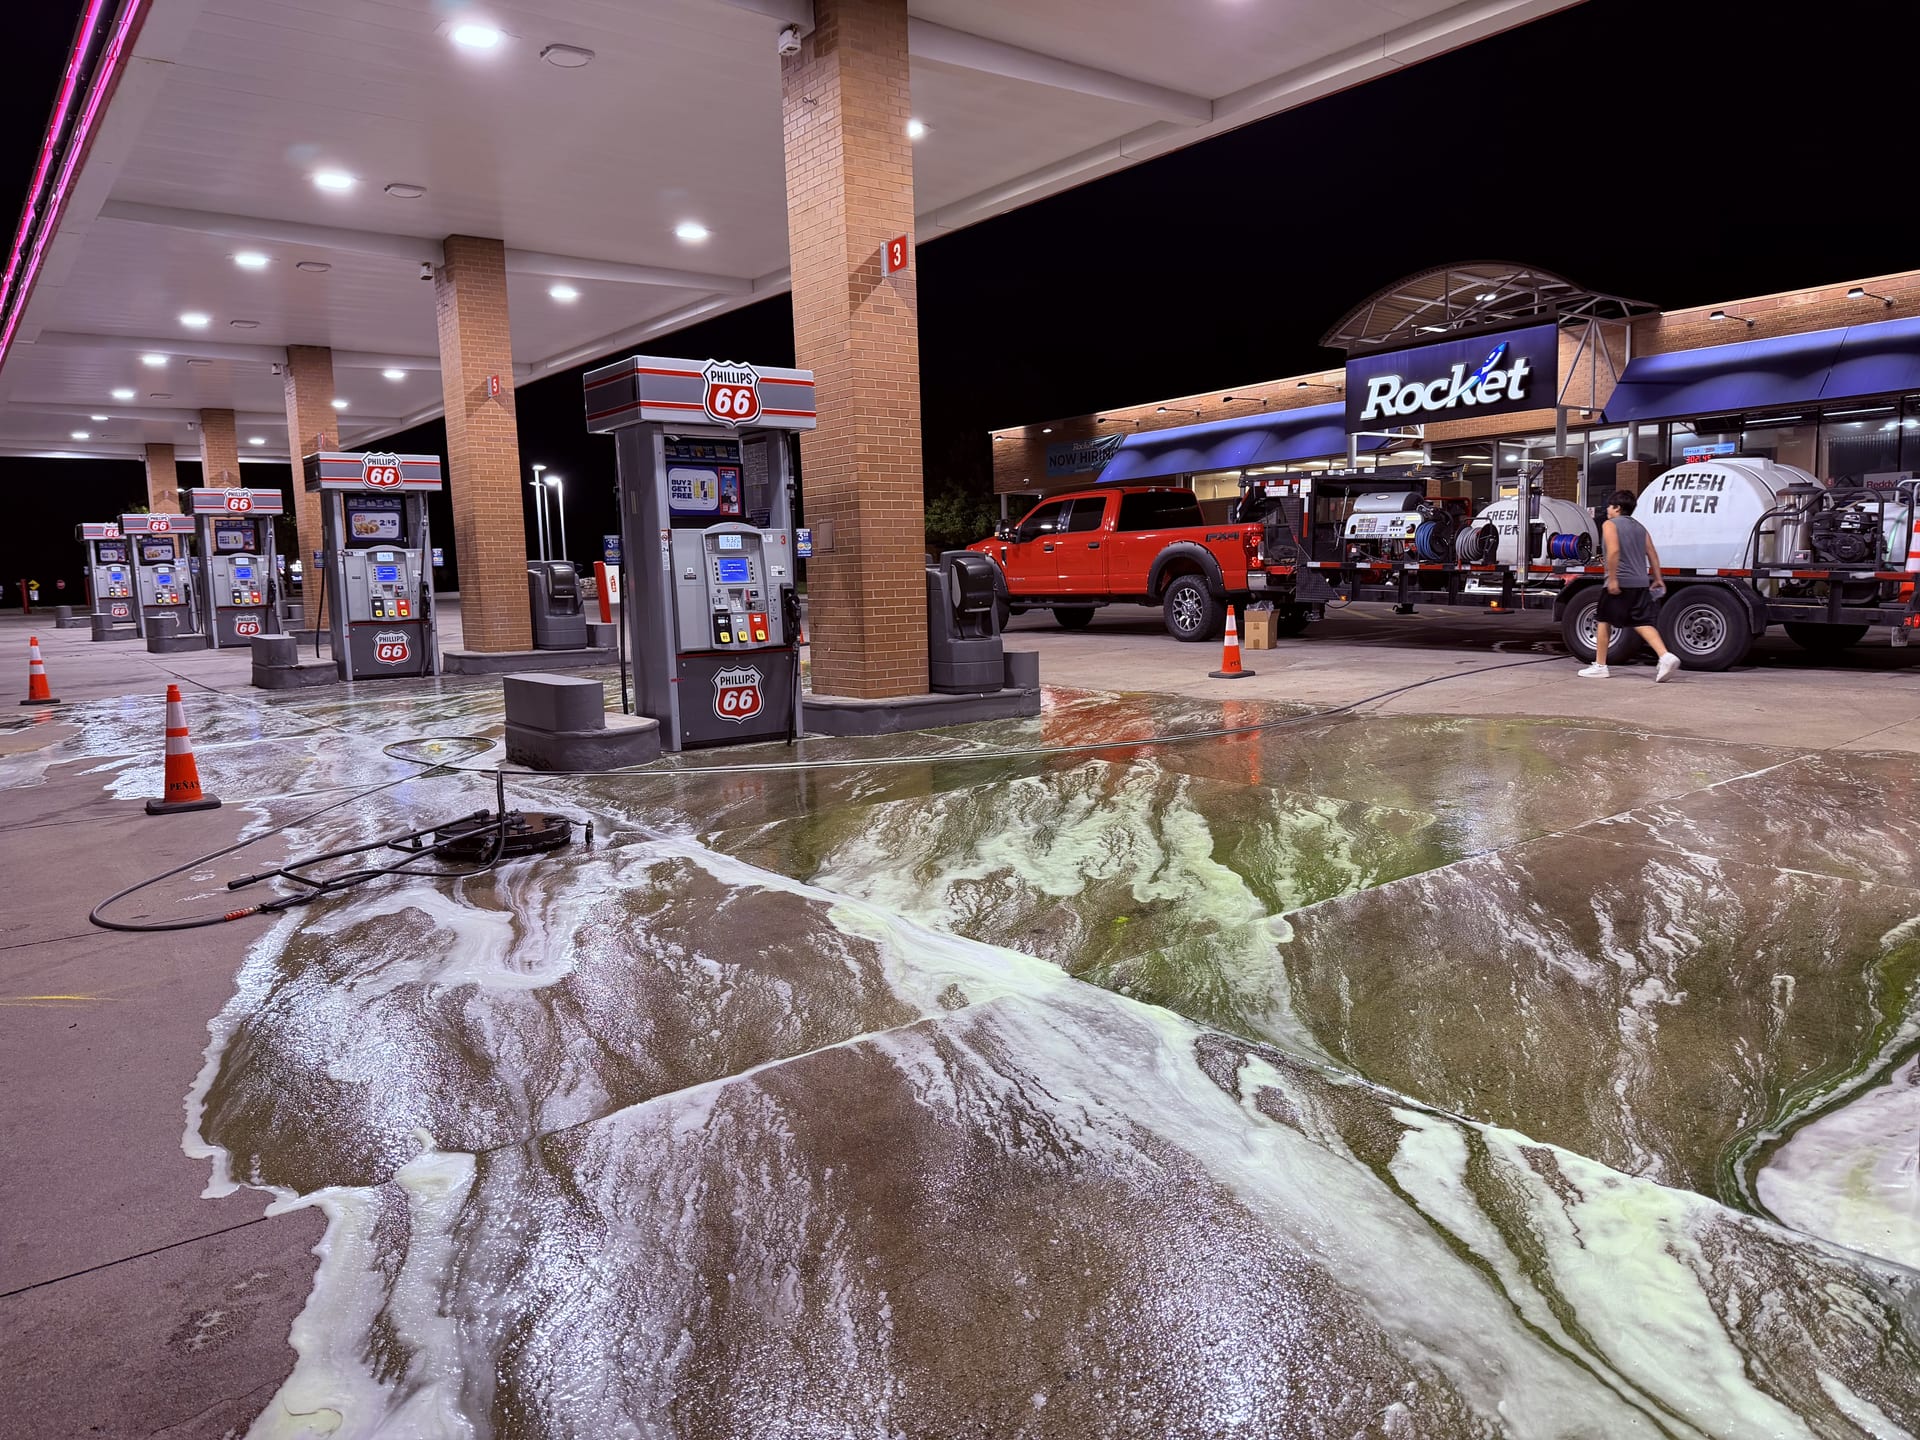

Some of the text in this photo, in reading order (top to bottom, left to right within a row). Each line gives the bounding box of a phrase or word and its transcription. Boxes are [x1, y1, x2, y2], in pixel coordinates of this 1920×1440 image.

[893, 243, 901, 266] 3
[710, 369, 753, 385] PHILLIPS
[493, 379, 498, 392] 5
[1360, 356, 1530, 422] Rocket
[715, 387, 751, 415] 66
[367, 457, 397, 466] PHILLIPS
[1048, 447, 1114, 467] NOW HIRIN
[369, 467, 396, 484] 66
[1661, 473, 1727, 492] FRESH
[229, 498, 249, 510] 66
[1653, 494, 1720, 514] WATER
[151, 521, 168, 531] 66
[1498, 524, 1520, 536] TER
[106, 529, 119, 537] 66
[780, 534, 786, 545] 3
[113, 607, 127, 616] 66
[238, 623, 256, 633] 66
[378, 635, 404, 643] PHILLIPS
[380, 645, 403, 659] 66
[719, 673, 756, 686] PHILLIPS
[722, 689, 754, 711] 66
